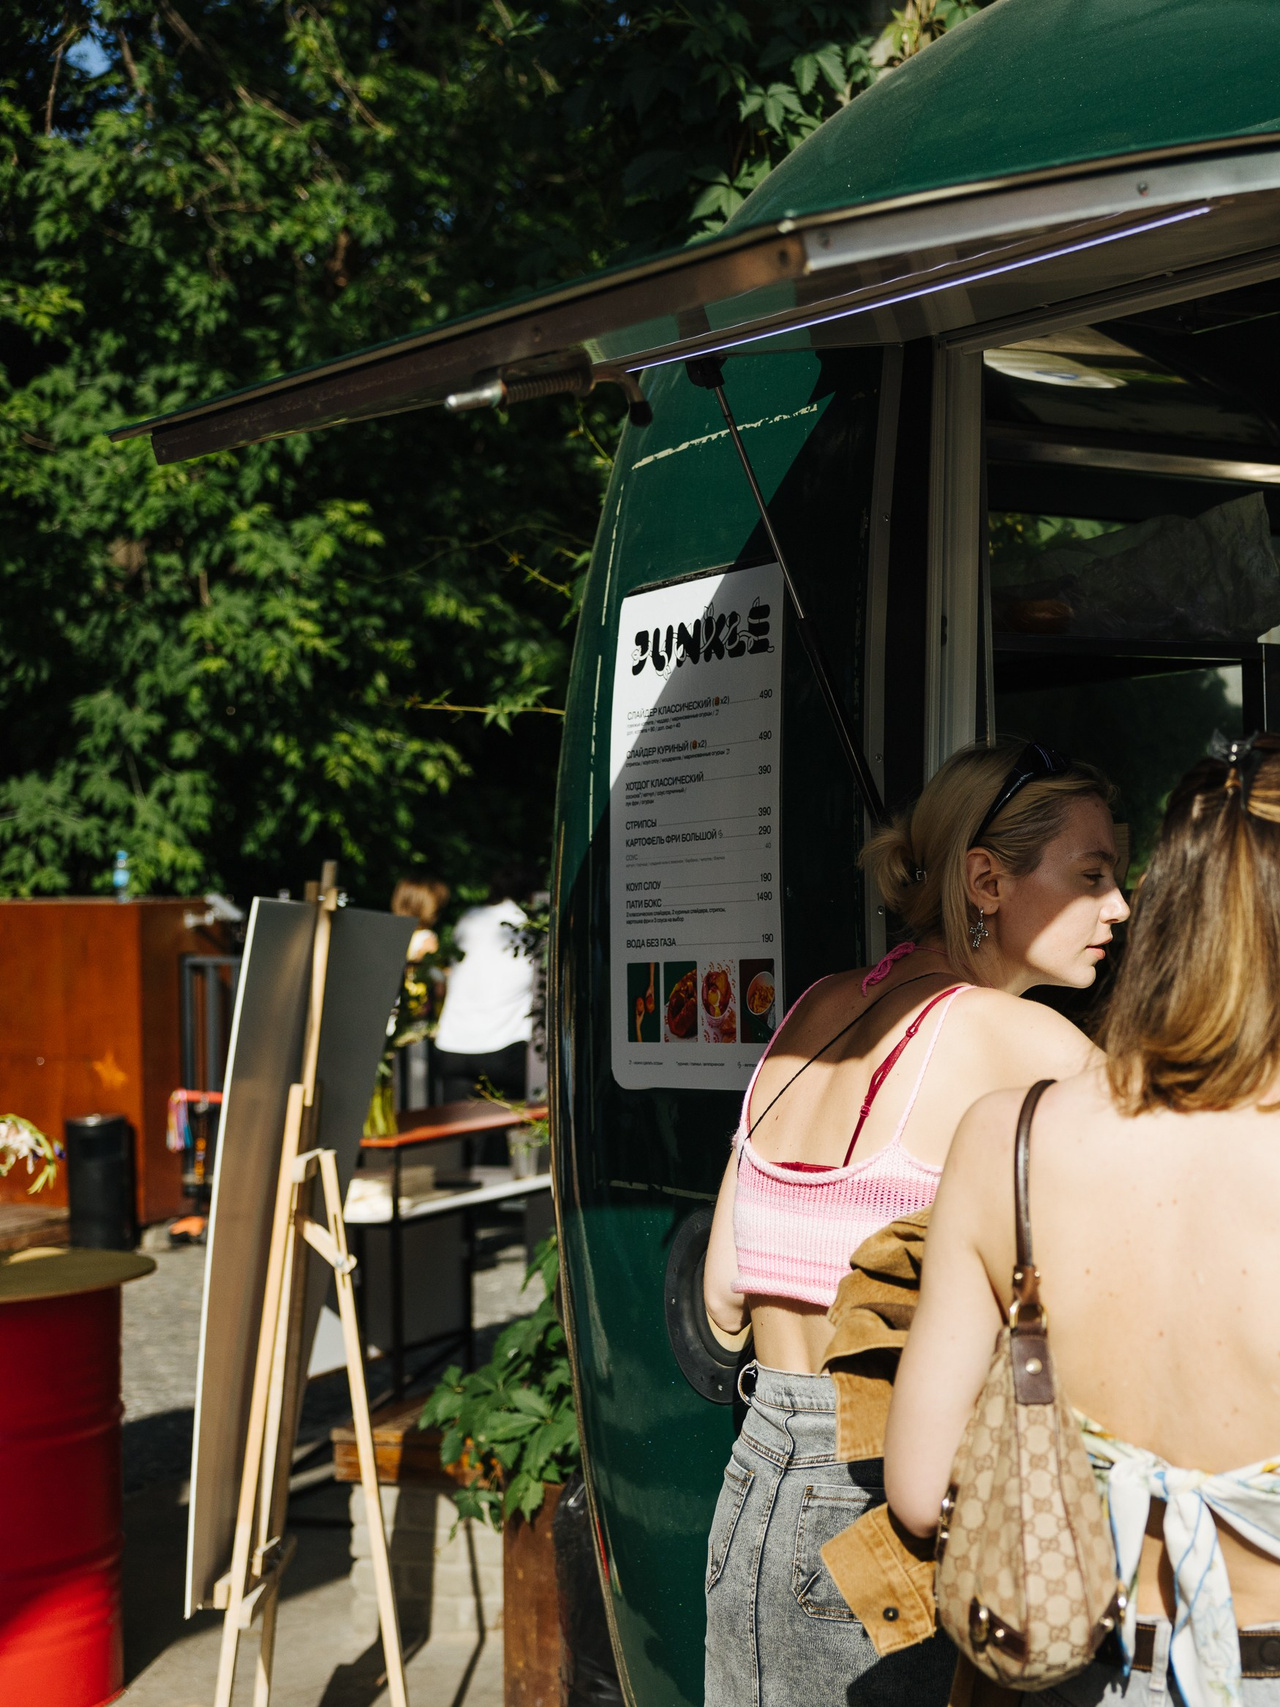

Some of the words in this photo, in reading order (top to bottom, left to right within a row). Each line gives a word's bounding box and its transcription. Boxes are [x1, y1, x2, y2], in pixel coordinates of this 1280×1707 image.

[632, 603, 771, 676] JUNKLE
[657, 697, 712, 716] КЛАССИЧЕСКИЙ
[759, 688, 773, 699] 490
[626, 746, 657, 759] СЛАЙДЕР
[657, 741, 689, 755] КУРИНЫЙ
[758, 730, 772, 741] 490
[625, 780, 650, 791] ХОТДОГ
[651, 771, 704, 788] КЛАССИЧЕСКИЙ
[758, 764, 771, 775] 390
[625, 818, 657, 830] СТРИПСЫ
[758, 806, 771, 817] 390
[625, 835, 665, 847] КАРТОФЕЛЬ
[665, 833, 680, 843] ФРИ
[681, 829, 717, 843] БОЛЬШОЙ
[758, 825, 771, 835] 290
[626, 881, 643, 892] КОУЛ
[643, 881, 661, 891] СЛОУ
[760, 872, 772, 882] 190
[626, 900, 643, 909] ПАТИ
[644, 899, 662, 908] БОКС
[756, 891, 773, 901] 1490
[626, 939, 645, 949] ВОДА
[646, 938, 659, 947] БЕЗ
[660, 938, 676, 947] ГАЗА
[762, 933, 774, 943] 190
